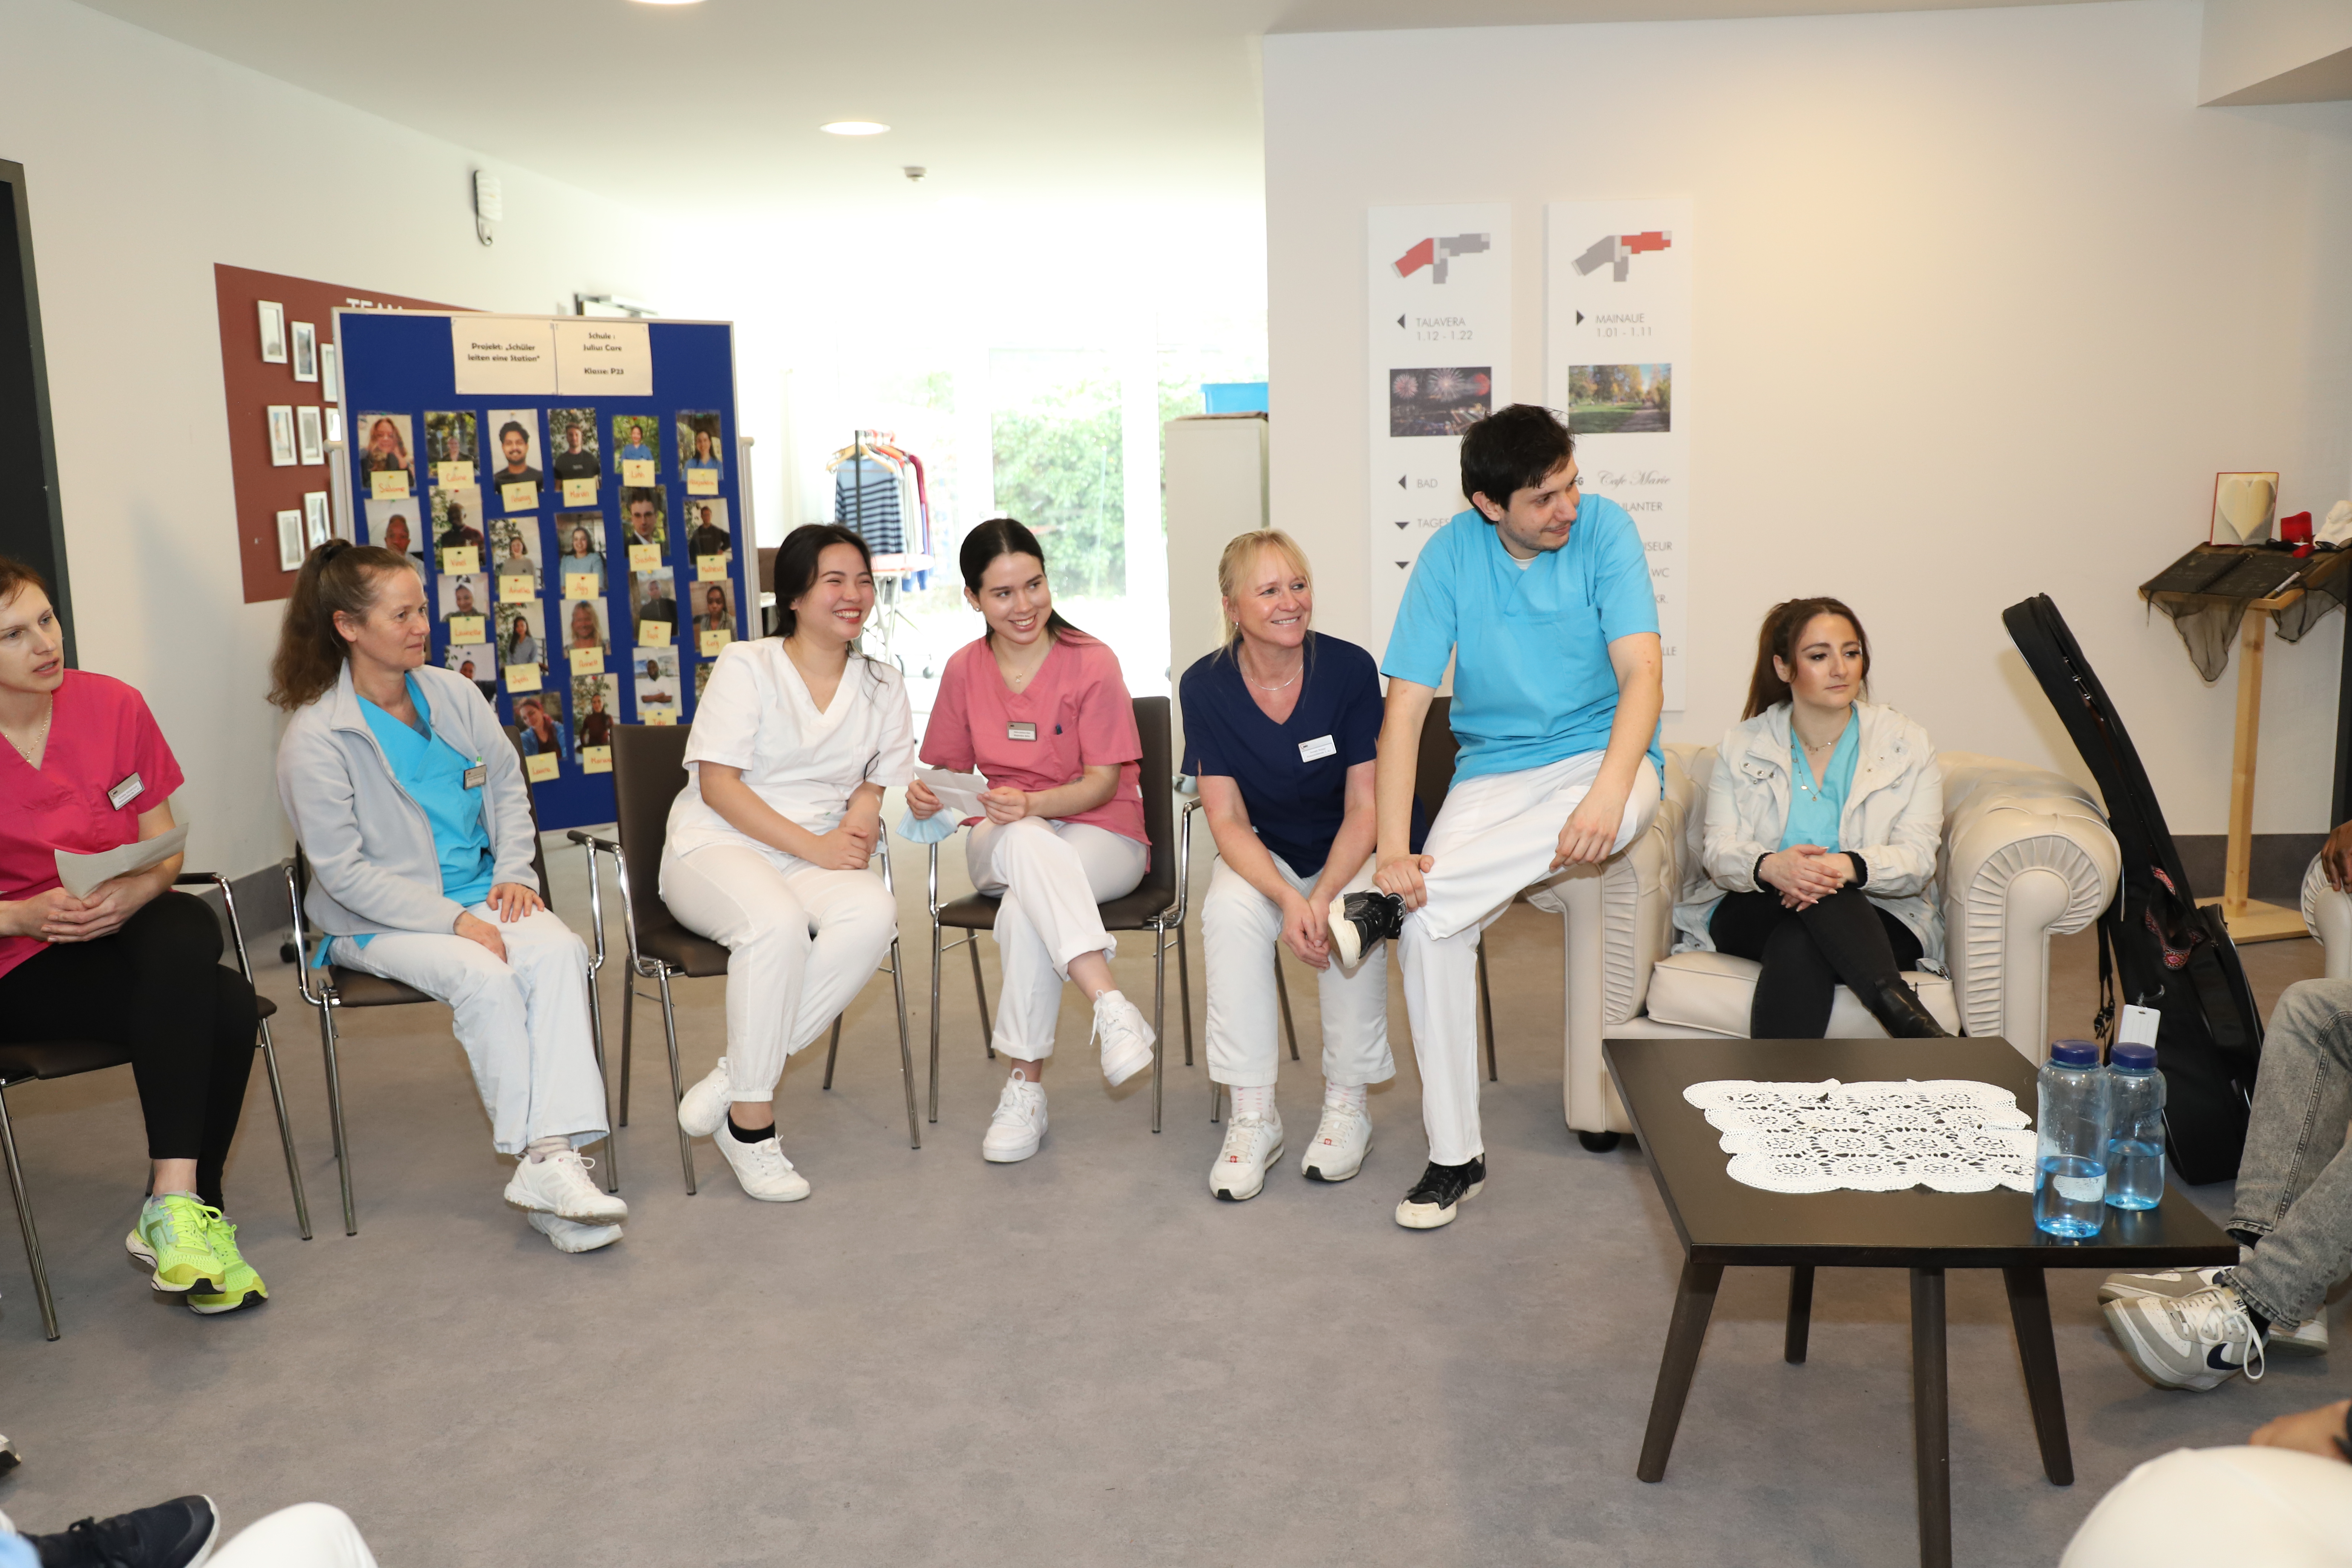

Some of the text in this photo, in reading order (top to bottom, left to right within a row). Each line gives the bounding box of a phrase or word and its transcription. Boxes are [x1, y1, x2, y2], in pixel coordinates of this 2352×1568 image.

[1416, 317, 1466, 327] TALAVERA
[1596, 313, 1645, 323] MAINAUE
[1417, 331, 1439, 341] 1.12
[1451, 330, 1473, 340] 1.22
[1597, 327, 1617, 337] 1.01
[1631, 326, 1652, 336] 1.11
[1629, 470, 1671, 485] Marie
[1417, 479, 1438, 488] BAD
[1652, 567, 1670, 577] WC
